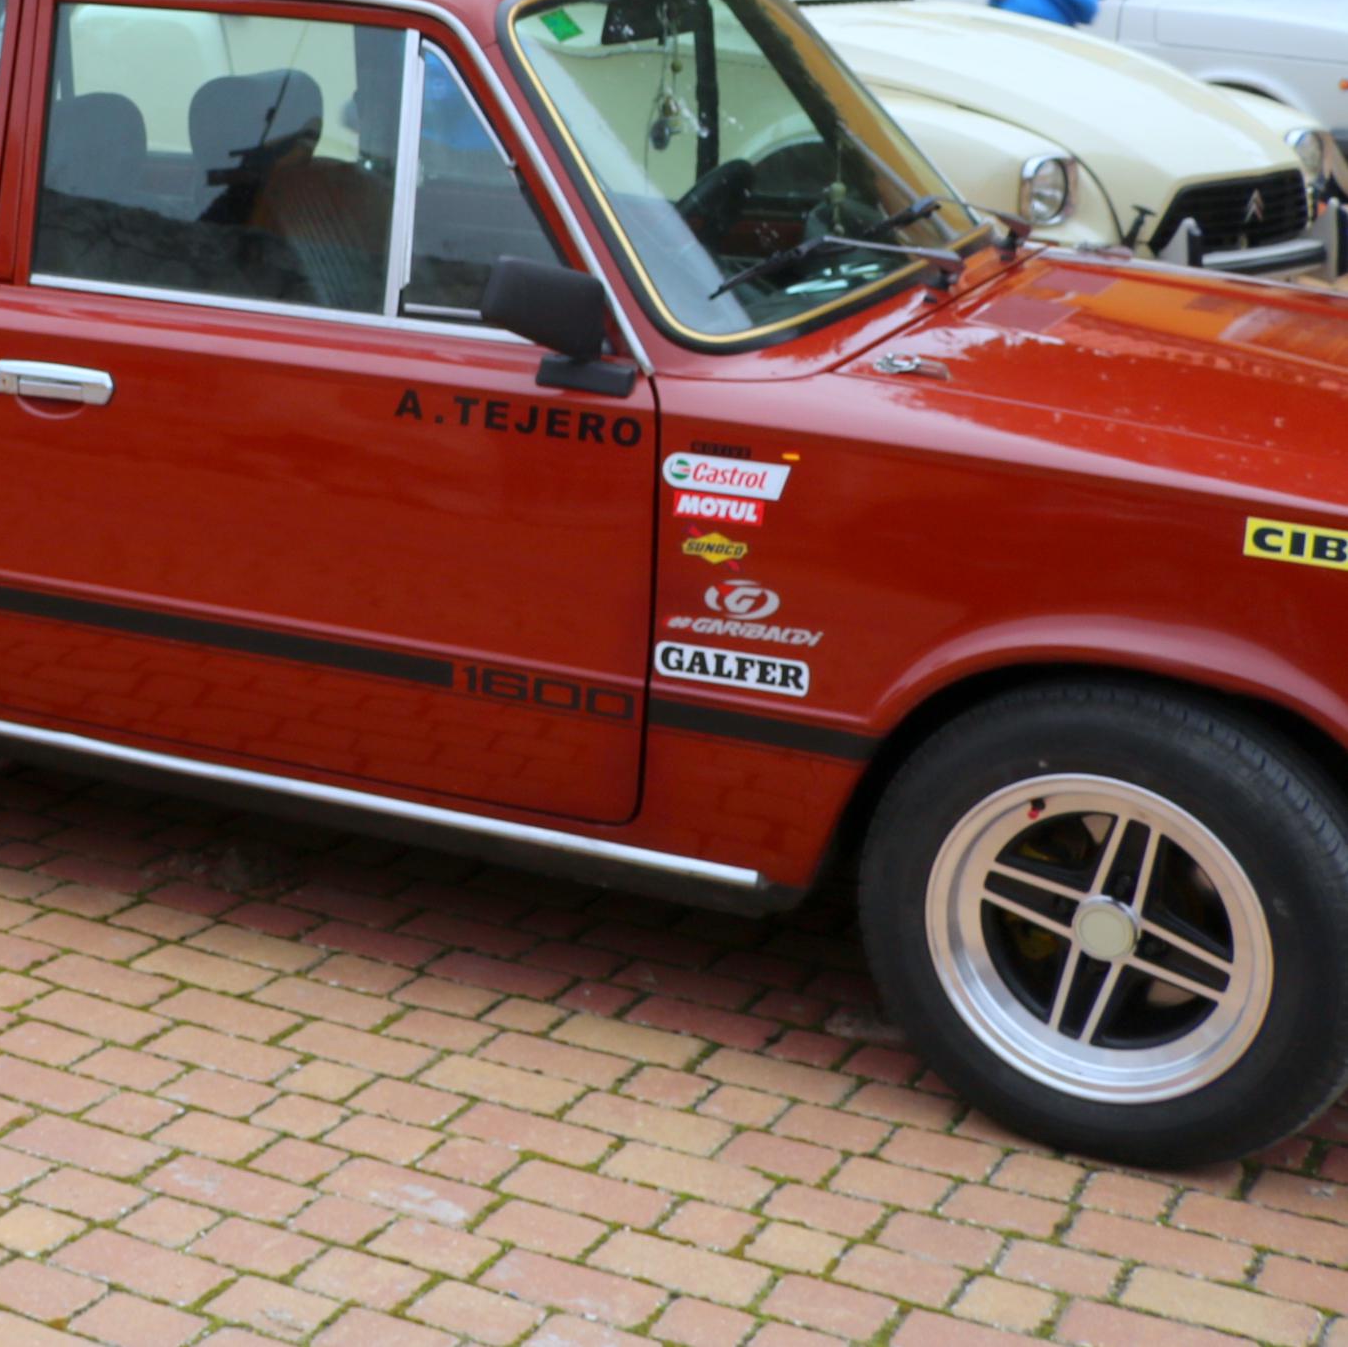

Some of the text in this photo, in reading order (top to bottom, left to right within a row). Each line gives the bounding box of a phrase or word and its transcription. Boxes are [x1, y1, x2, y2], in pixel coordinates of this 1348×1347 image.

[692, 462, 767, 490] Castrol
[676, 494, 758, 523] MOTUL
[686, 540, 744, 557] SUNOCO
[1252, 527, 1348, 562] CIB
[660, 646, 804, 690] GALFER
[464, 665, 634, 720] 1600
